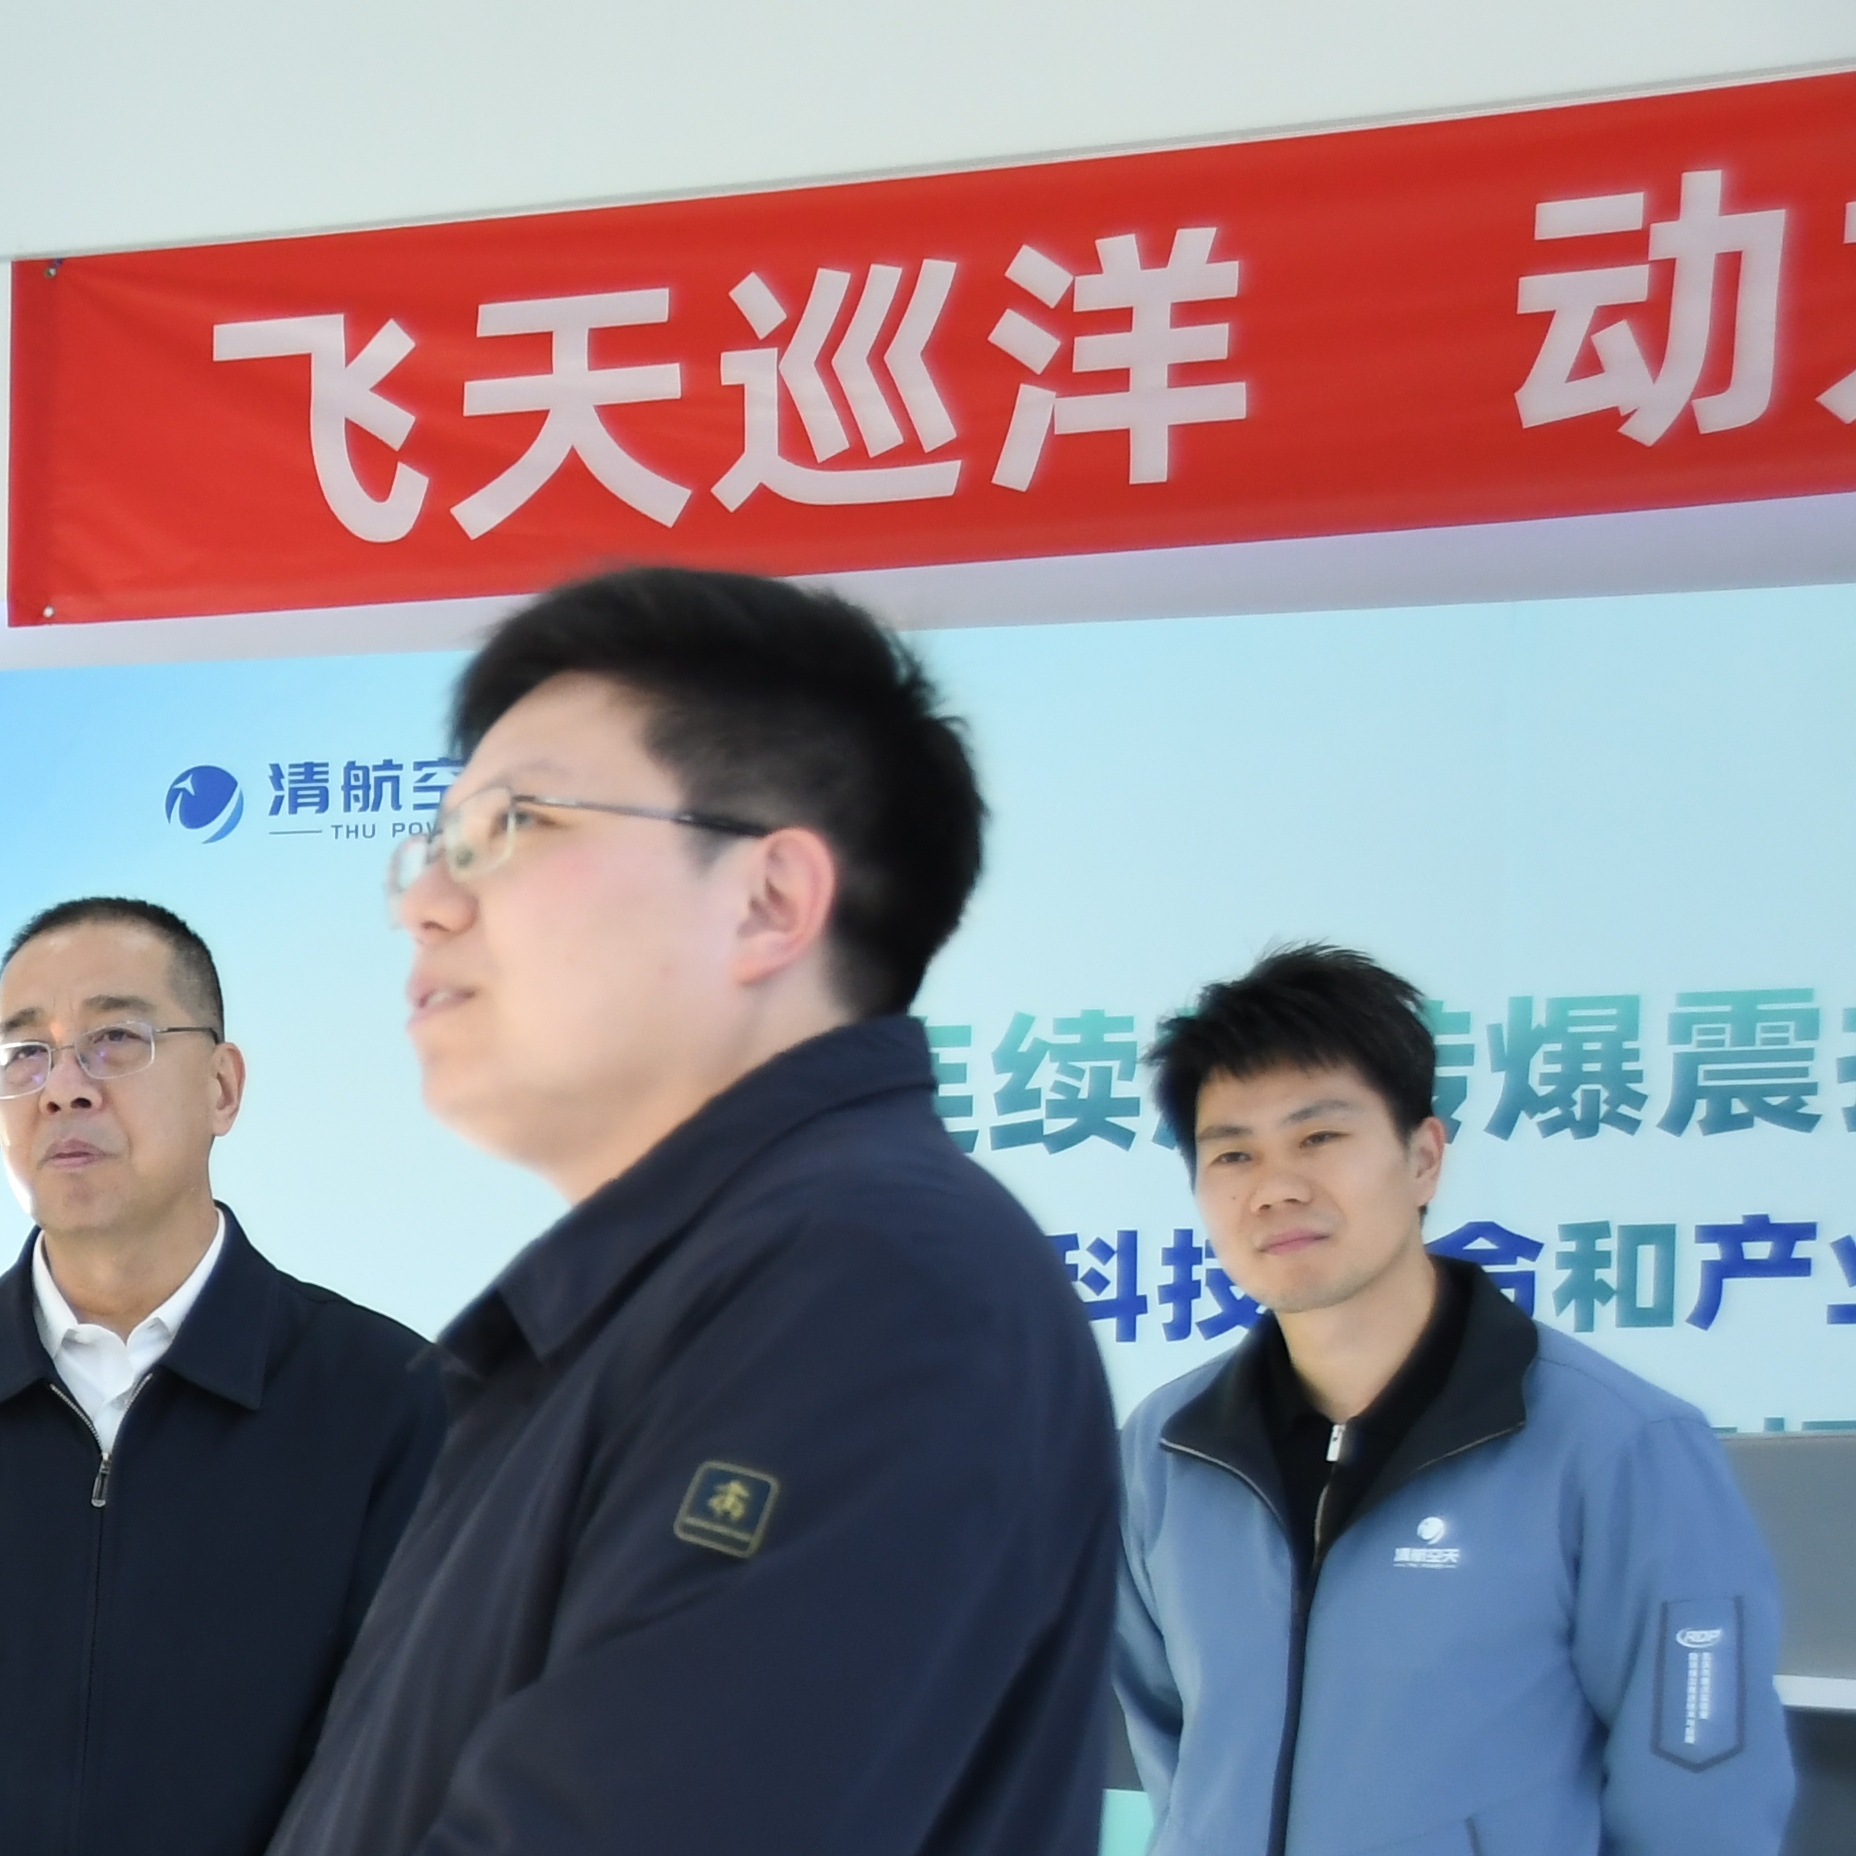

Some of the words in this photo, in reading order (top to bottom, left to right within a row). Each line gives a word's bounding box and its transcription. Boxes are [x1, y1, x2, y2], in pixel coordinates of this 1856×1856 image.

[210, 226, 1250, 544] 飞天巡洋
[1514, 169, 1856, 447] 动
[330, 823, 376, 841] THU
